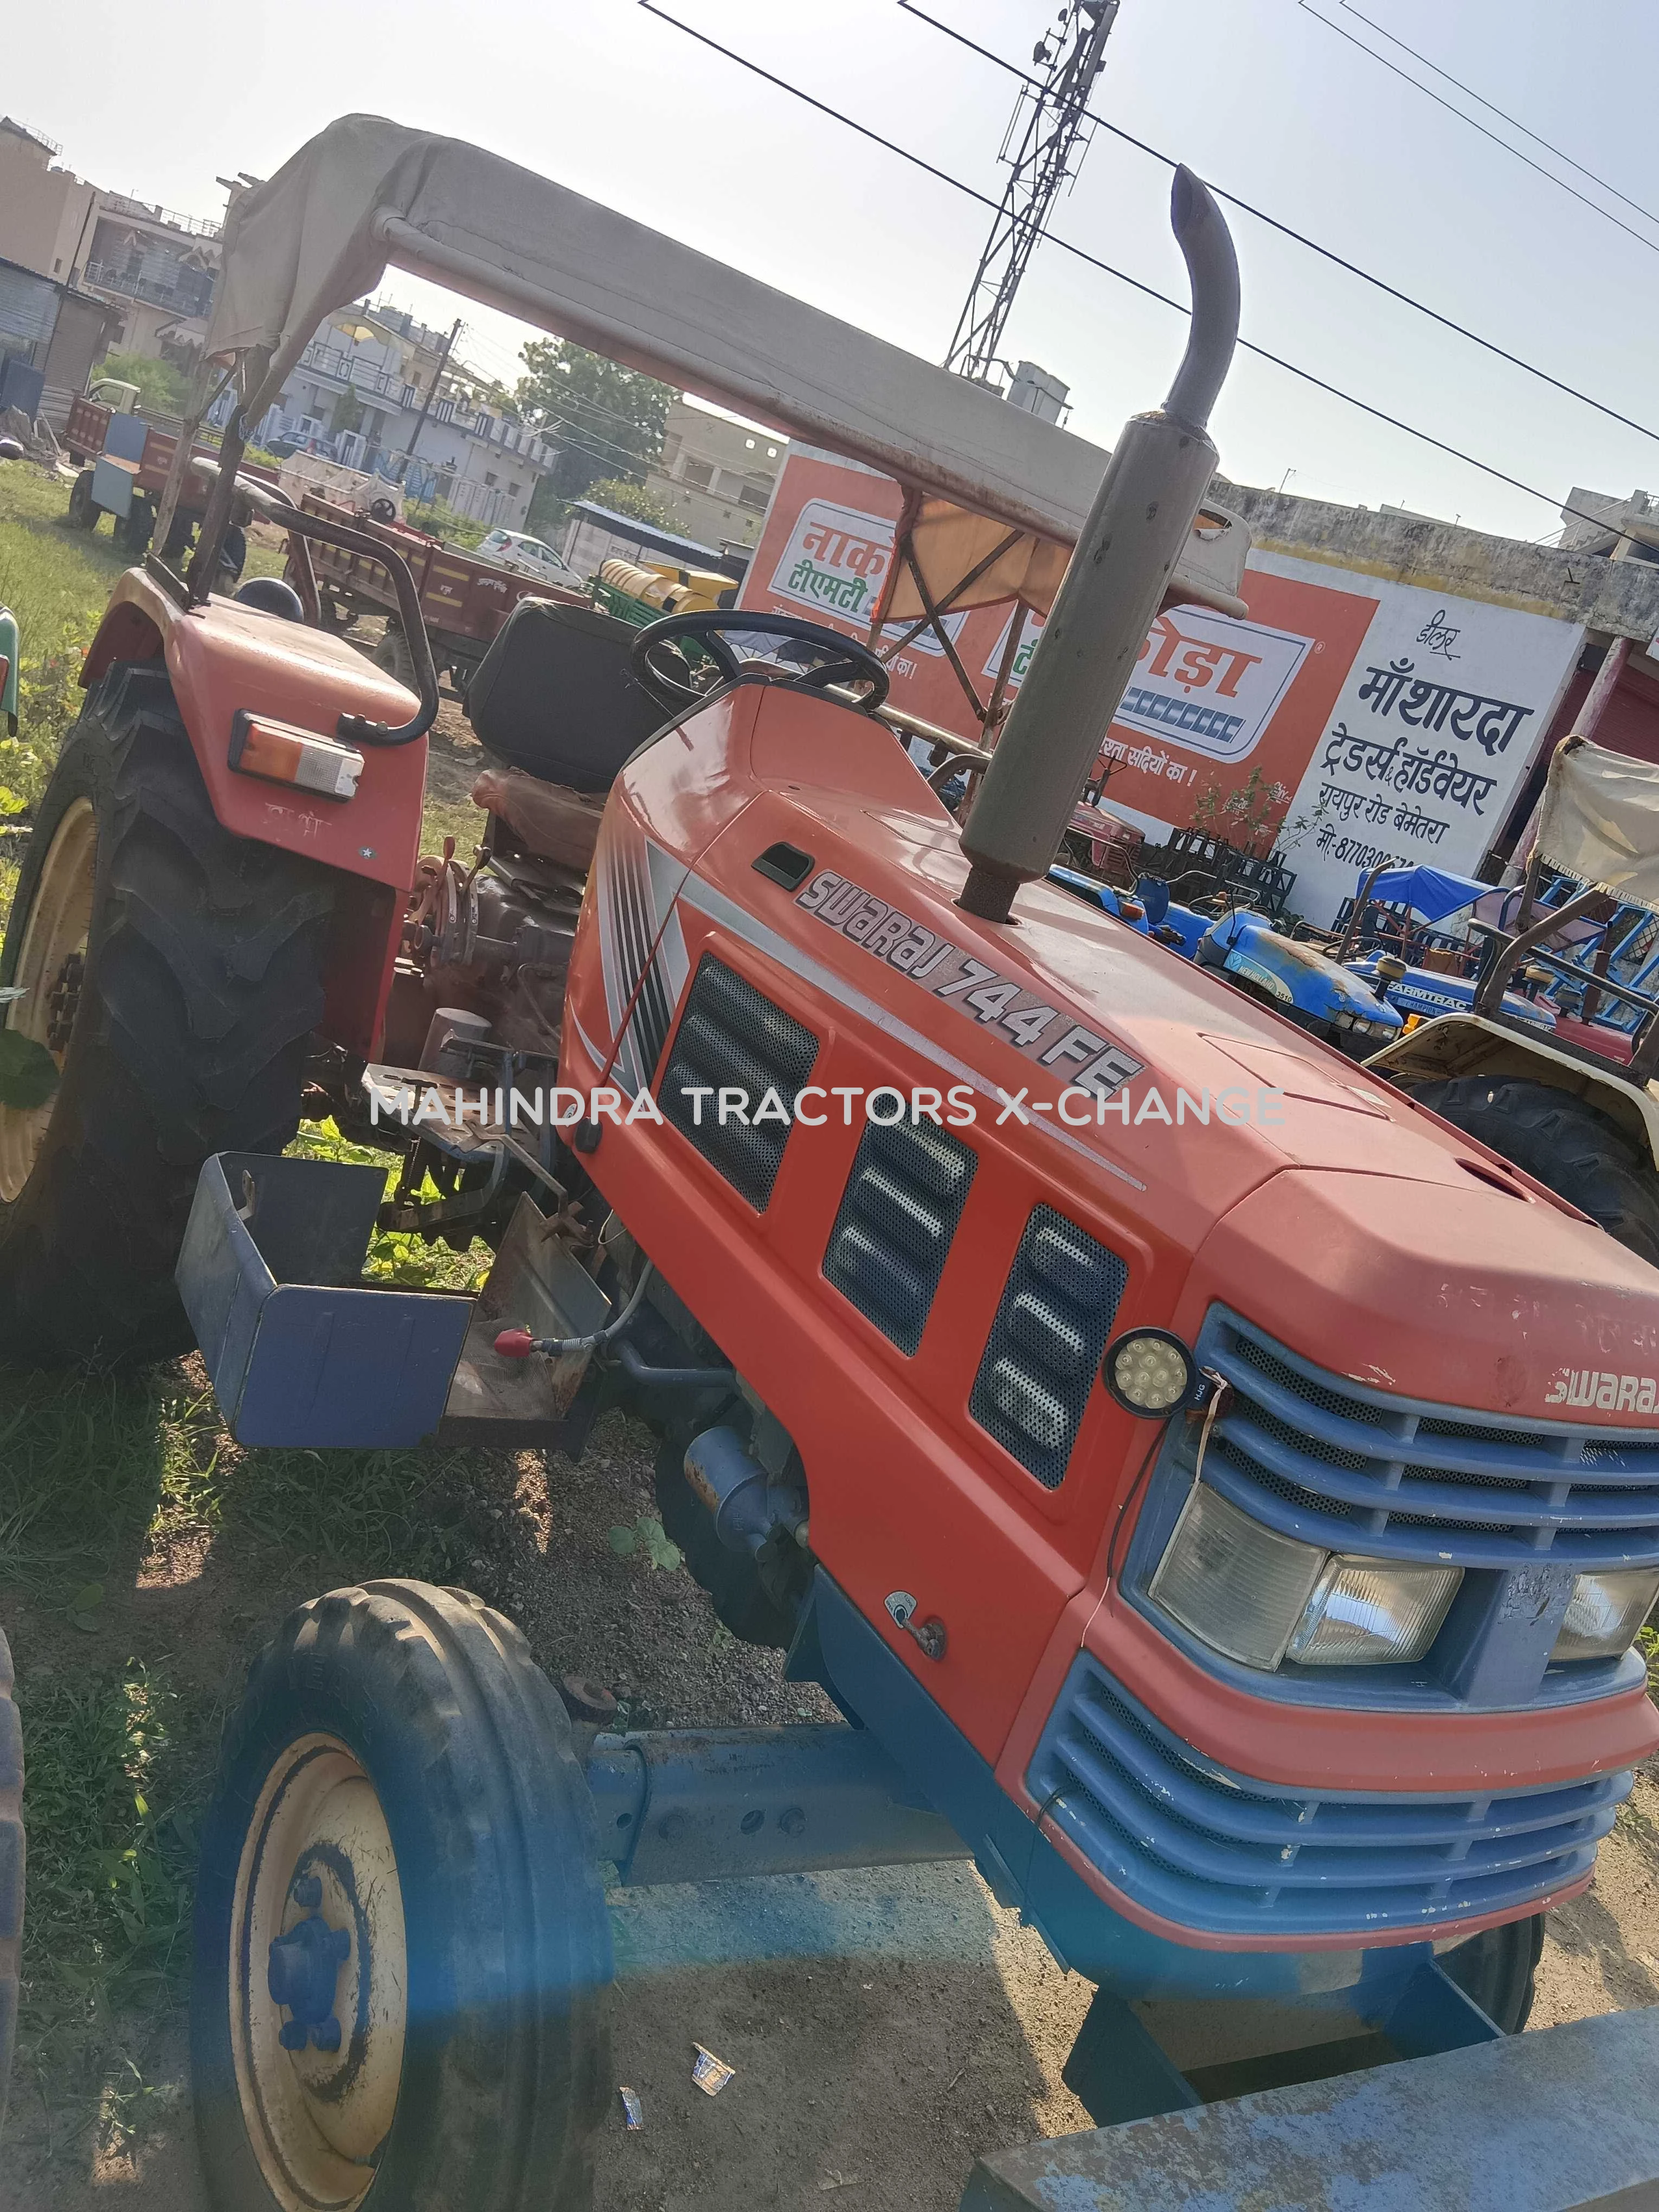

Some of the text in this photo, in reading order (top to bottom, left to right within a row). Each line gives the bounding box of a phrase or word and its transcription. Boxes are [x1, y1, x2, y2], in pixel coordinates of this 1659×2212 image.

[788, 560, 869, 613] टीएमटी
[1416, 609, 1461, 660] डीलर
[1399, 679, 1535, 756] शारदा
[1320, 782, 1450, 844] रायपुर रोड बेमेतरा
[1238, 966, 1275, 990] NEW HOLLAND
[1276, 991, 1292, 1002] 3510
[933, 959, 1060, 1047] 744
[1041, 1024, 1146, 1101] FE
[1194, 1383, 1206, 1401] HJG
[1545, 1367, 1659, 1414] SWARA
